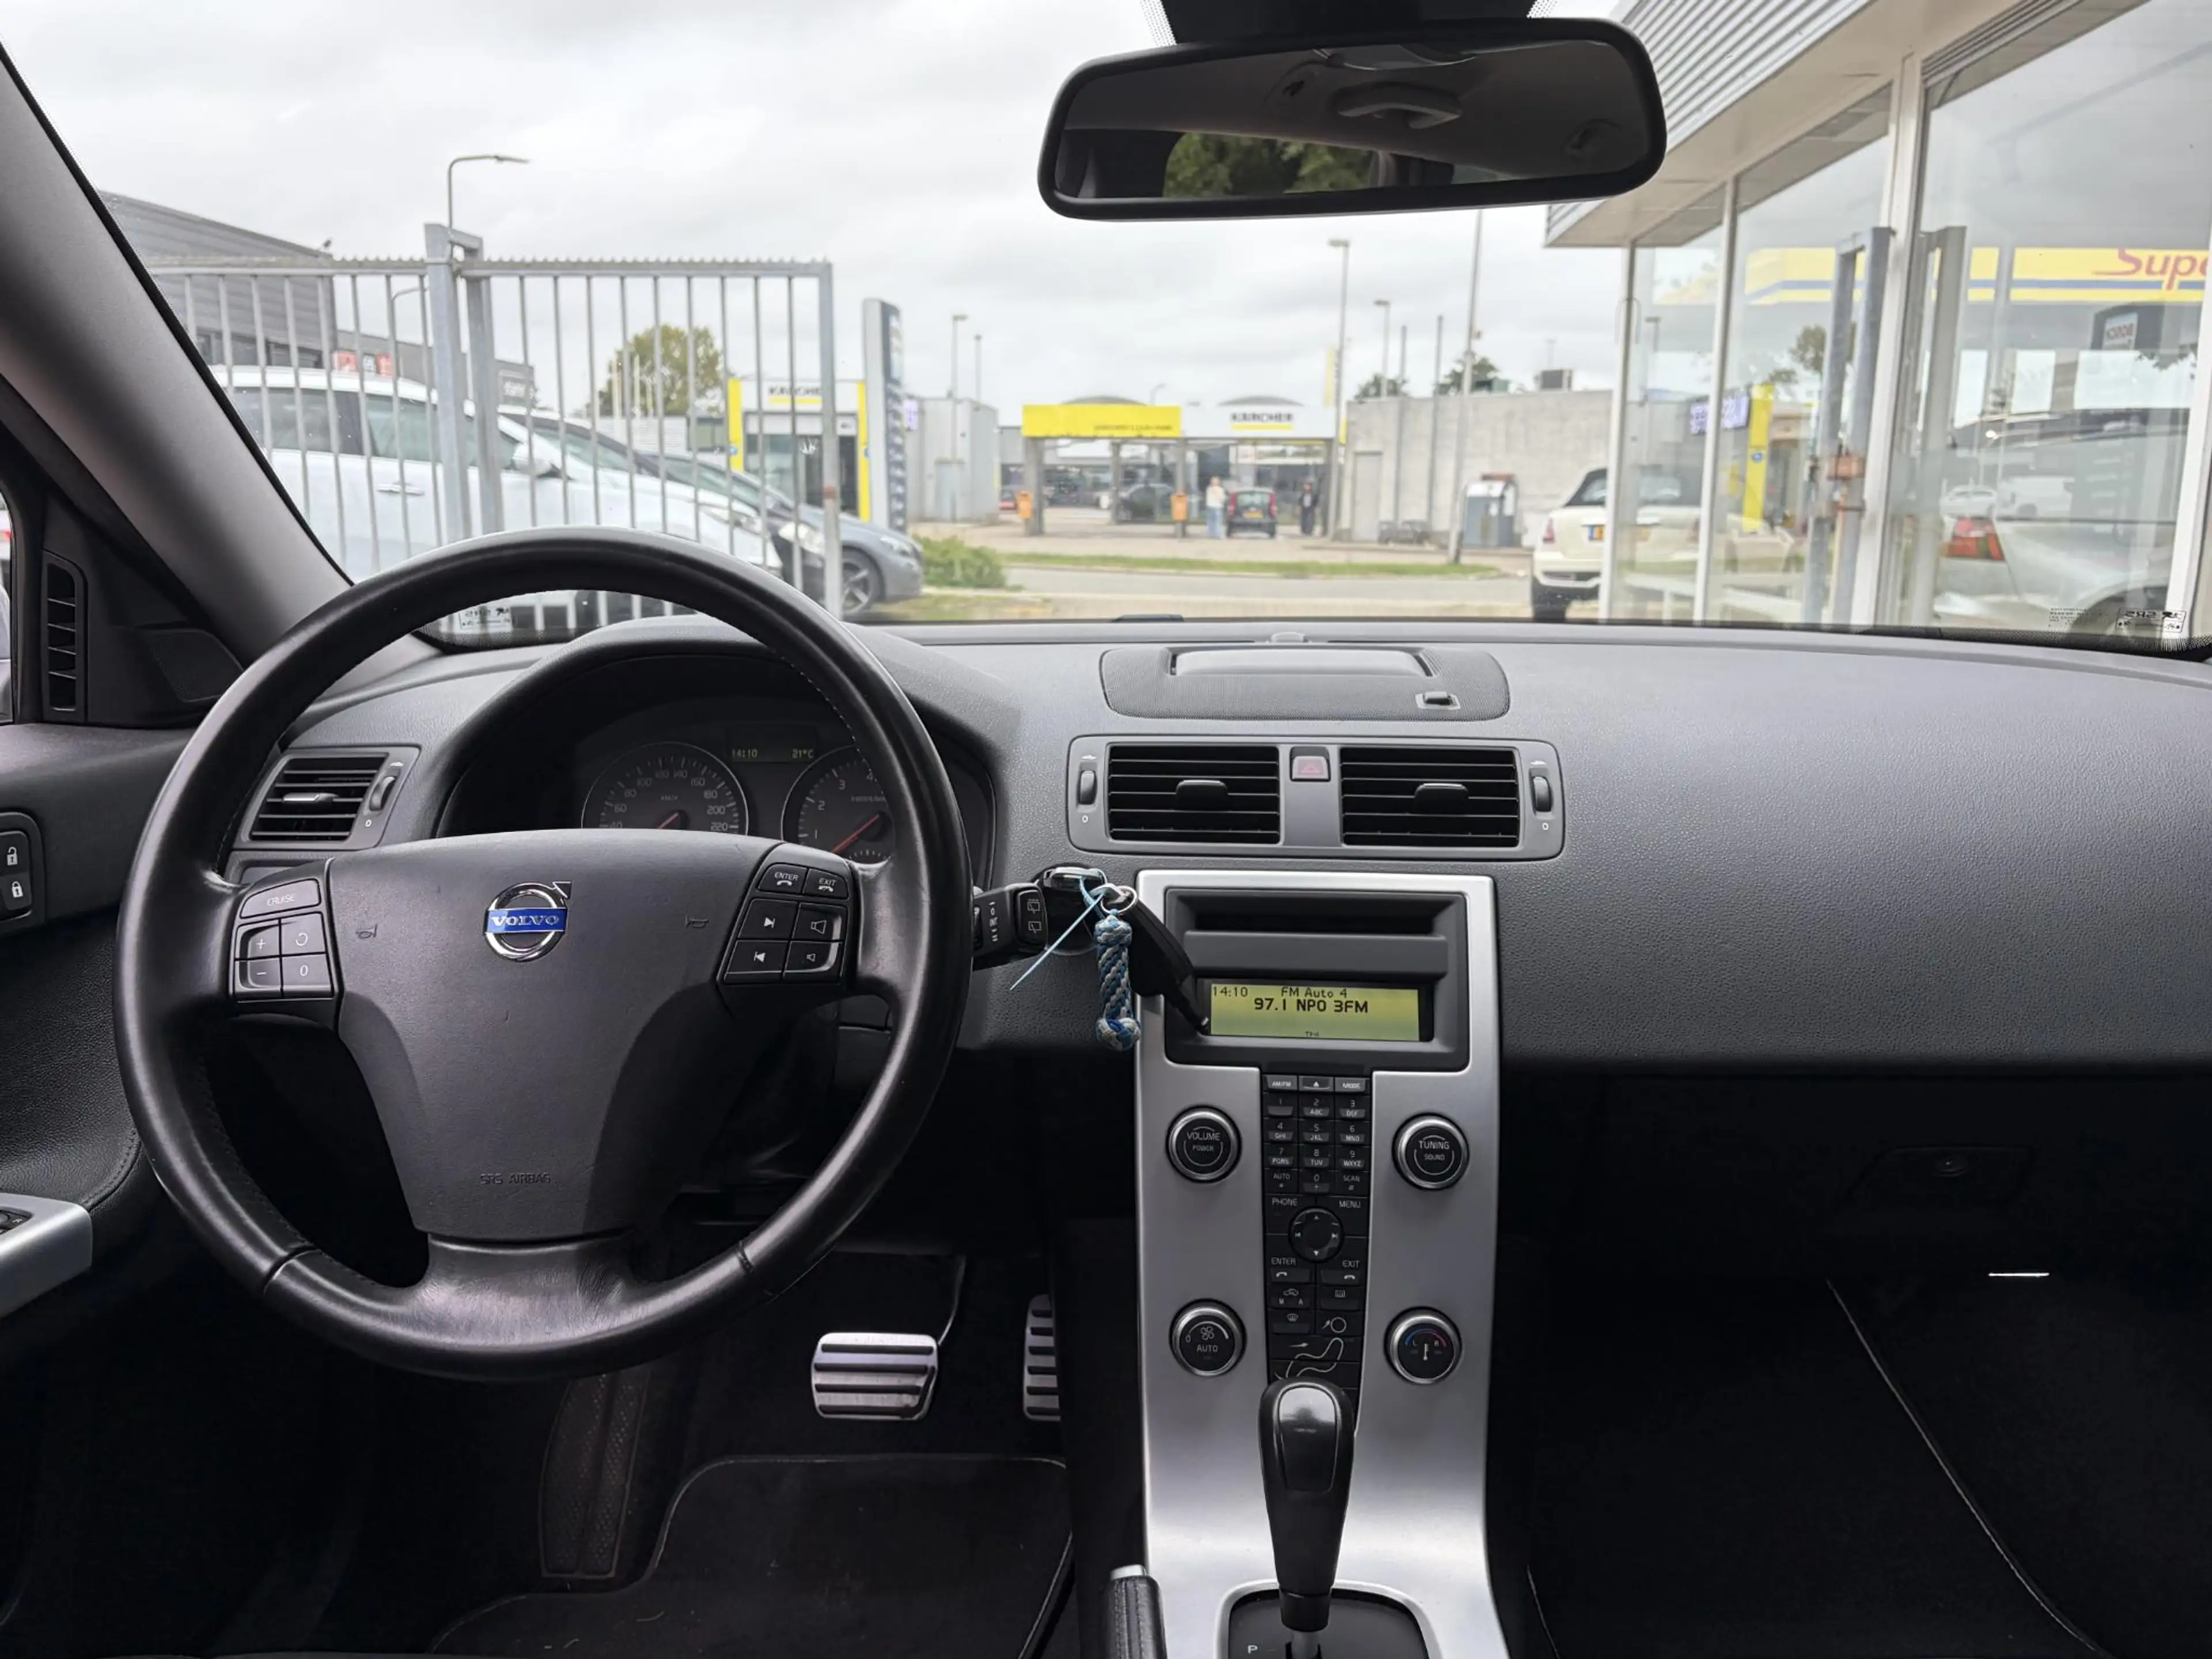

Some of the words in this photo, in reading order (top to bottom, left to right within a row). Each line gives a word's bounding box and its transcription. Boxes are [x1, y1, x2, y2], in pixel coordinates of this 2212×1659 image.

[732, 749, 758, 759] 14:10
[839, 779, 846, 790] 3
[614, 804, 627, 812] 60
[707, 805, 726, 815] 200
[817, 800, 826, 811] 2
[710, 821, 728, 832] 220
[774, 872, 799, 881] ENTER
[819, 877, 836, 887] EXIT
[267, 893, 296, 907] CRUISE
[491, 914, 560, 927] VOLVO
[1211, 986, 1248, 998] 14:10
[1281, 986, 1300, 997] FM
[1304, 987, 1334, 998] Auto
[1339, 987, 1347, 998] 4
[1253, 997, 1287, 1012] 97.1
[1296, 998, 1327, 1012] NPO
[1334, 999, 1369, 1013] 3FM
[1187, 1132, 1221, 1141] VOLUME
[1418, 1140, 1450, 1150] TUNING
[509, 1172, 551, 1184] AIRBAG
[1272, 1198, 1297, 1206] PHONE
[1339, 1200, 1361, 1209] MENU
[1271, 1257, 1296, 1266] ENTER
[1342, 1260, 1360, 1268] EXIT
[1196, 1344, 1218, 1352] AUTO
[1248, 1644, 1258, 1654] P
